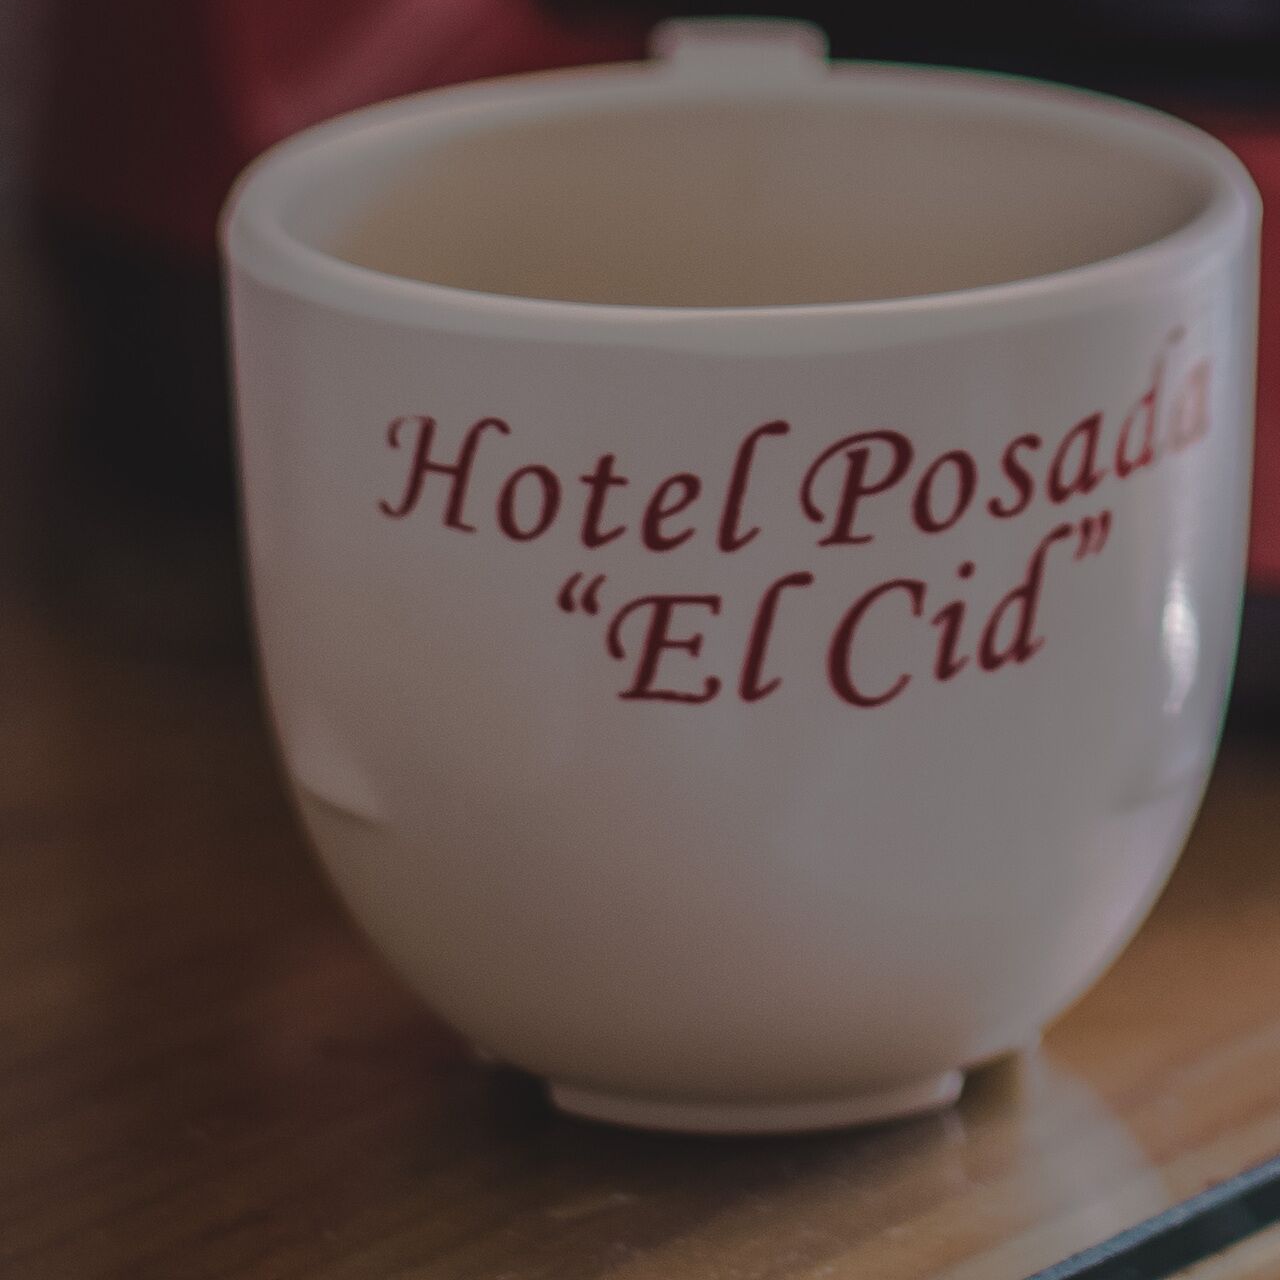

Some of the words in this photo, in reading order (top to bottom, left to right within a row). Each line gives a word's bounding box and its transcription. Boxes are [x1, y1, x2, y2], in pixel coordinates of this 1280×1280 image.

[378, 414, 791, 553] Hotel
[799, 326, 1214, 548] Posada
[557, 571, 815, 705] “El
[826, 510, 1114, 709] Cid”
